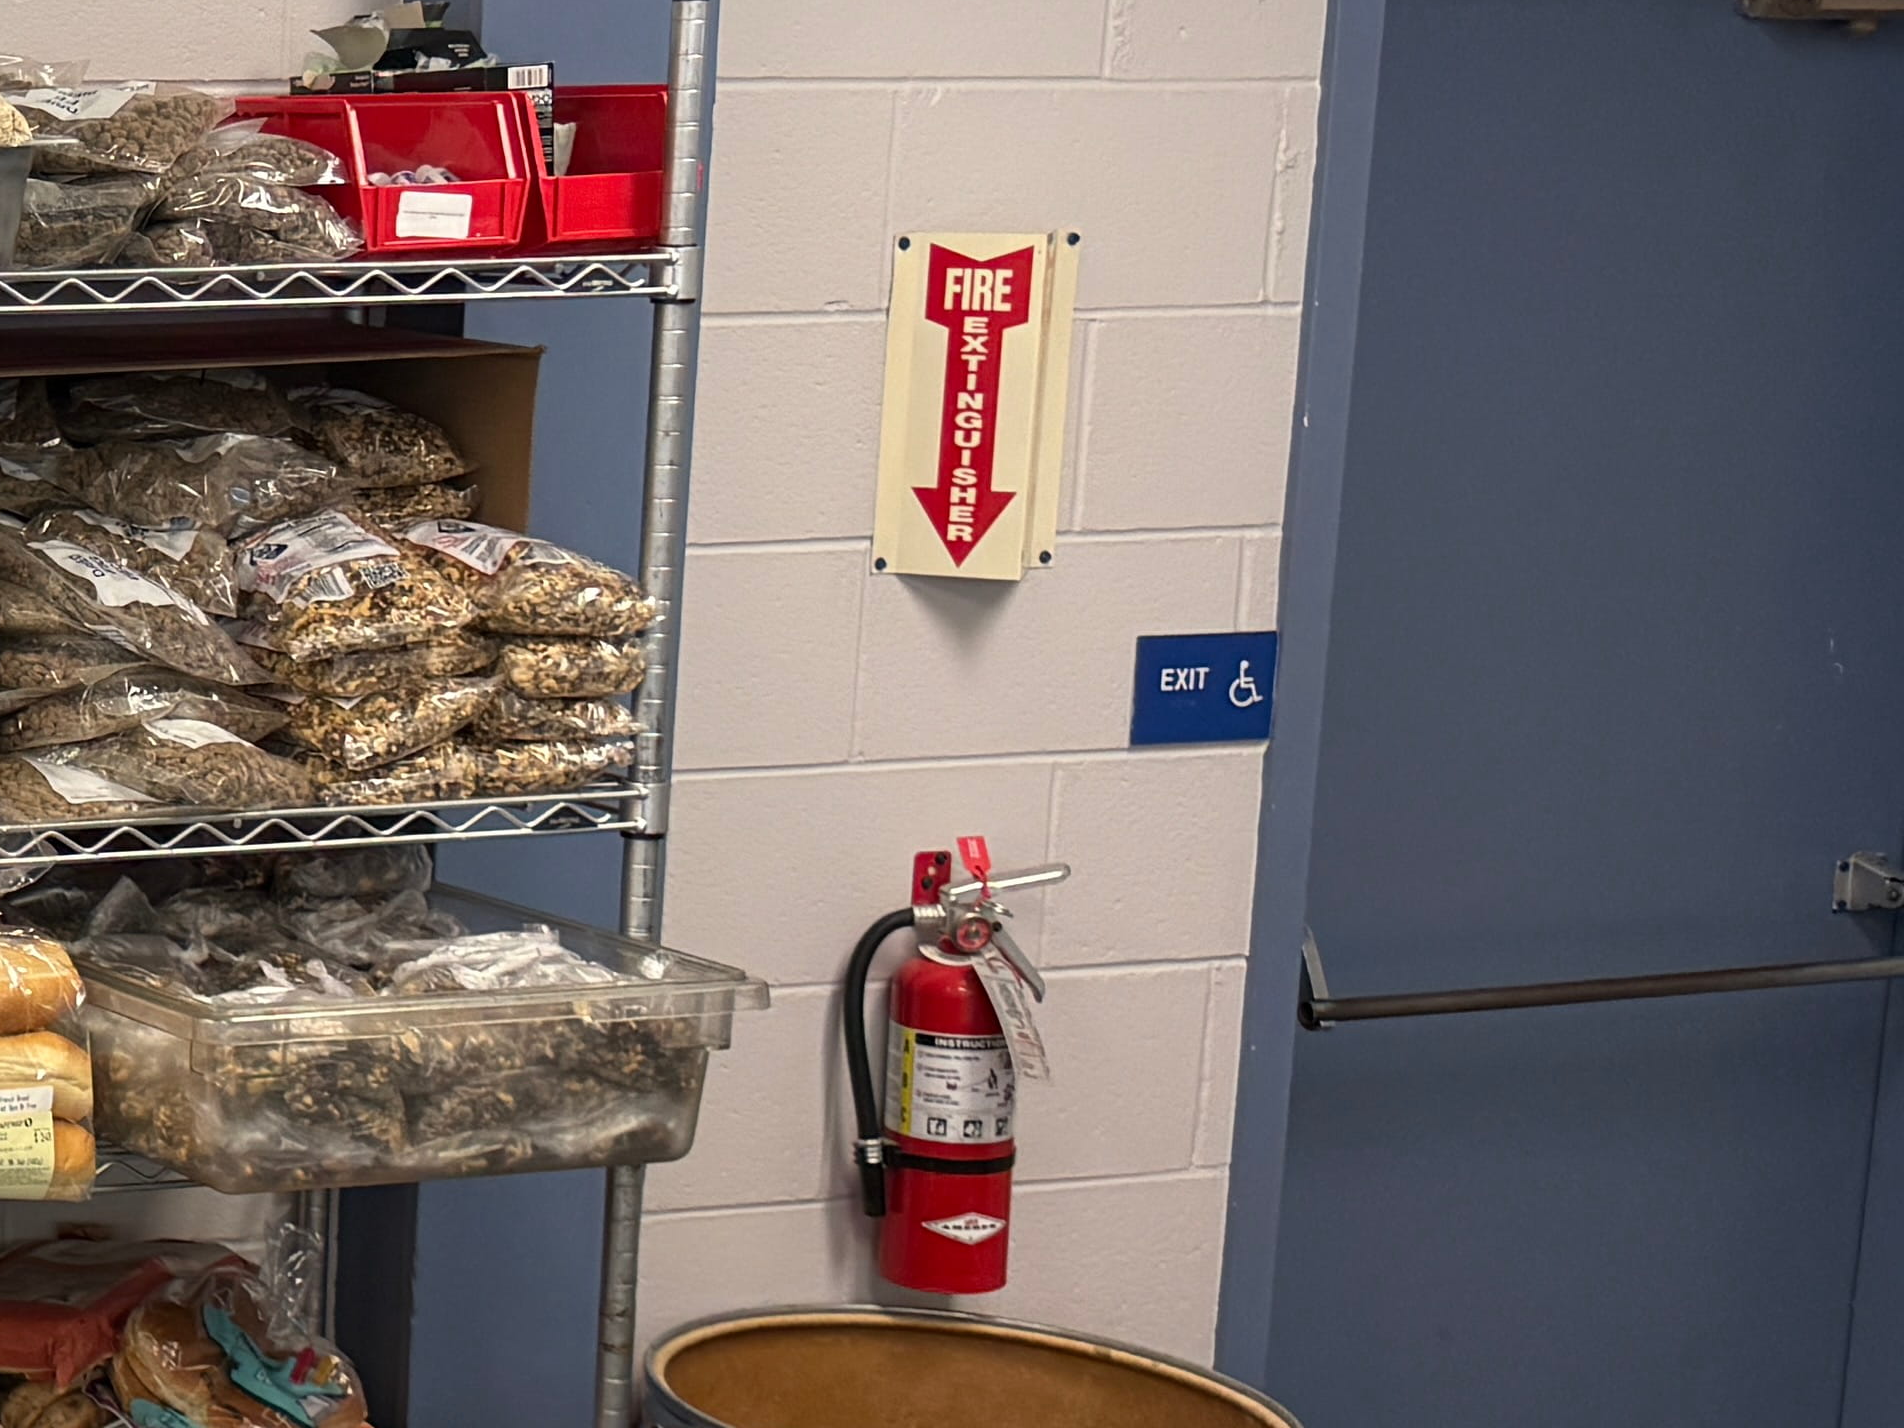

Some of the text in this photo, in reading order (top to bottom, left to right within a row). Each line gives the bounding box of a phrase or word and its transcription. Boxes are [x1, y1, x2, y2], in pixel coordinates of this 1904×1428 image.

[945, 268, 1014, 312] FIRE
[946, 317, 989, 542] EXTINGUISHER
[1161, 667, 1209, 692] EXIT
